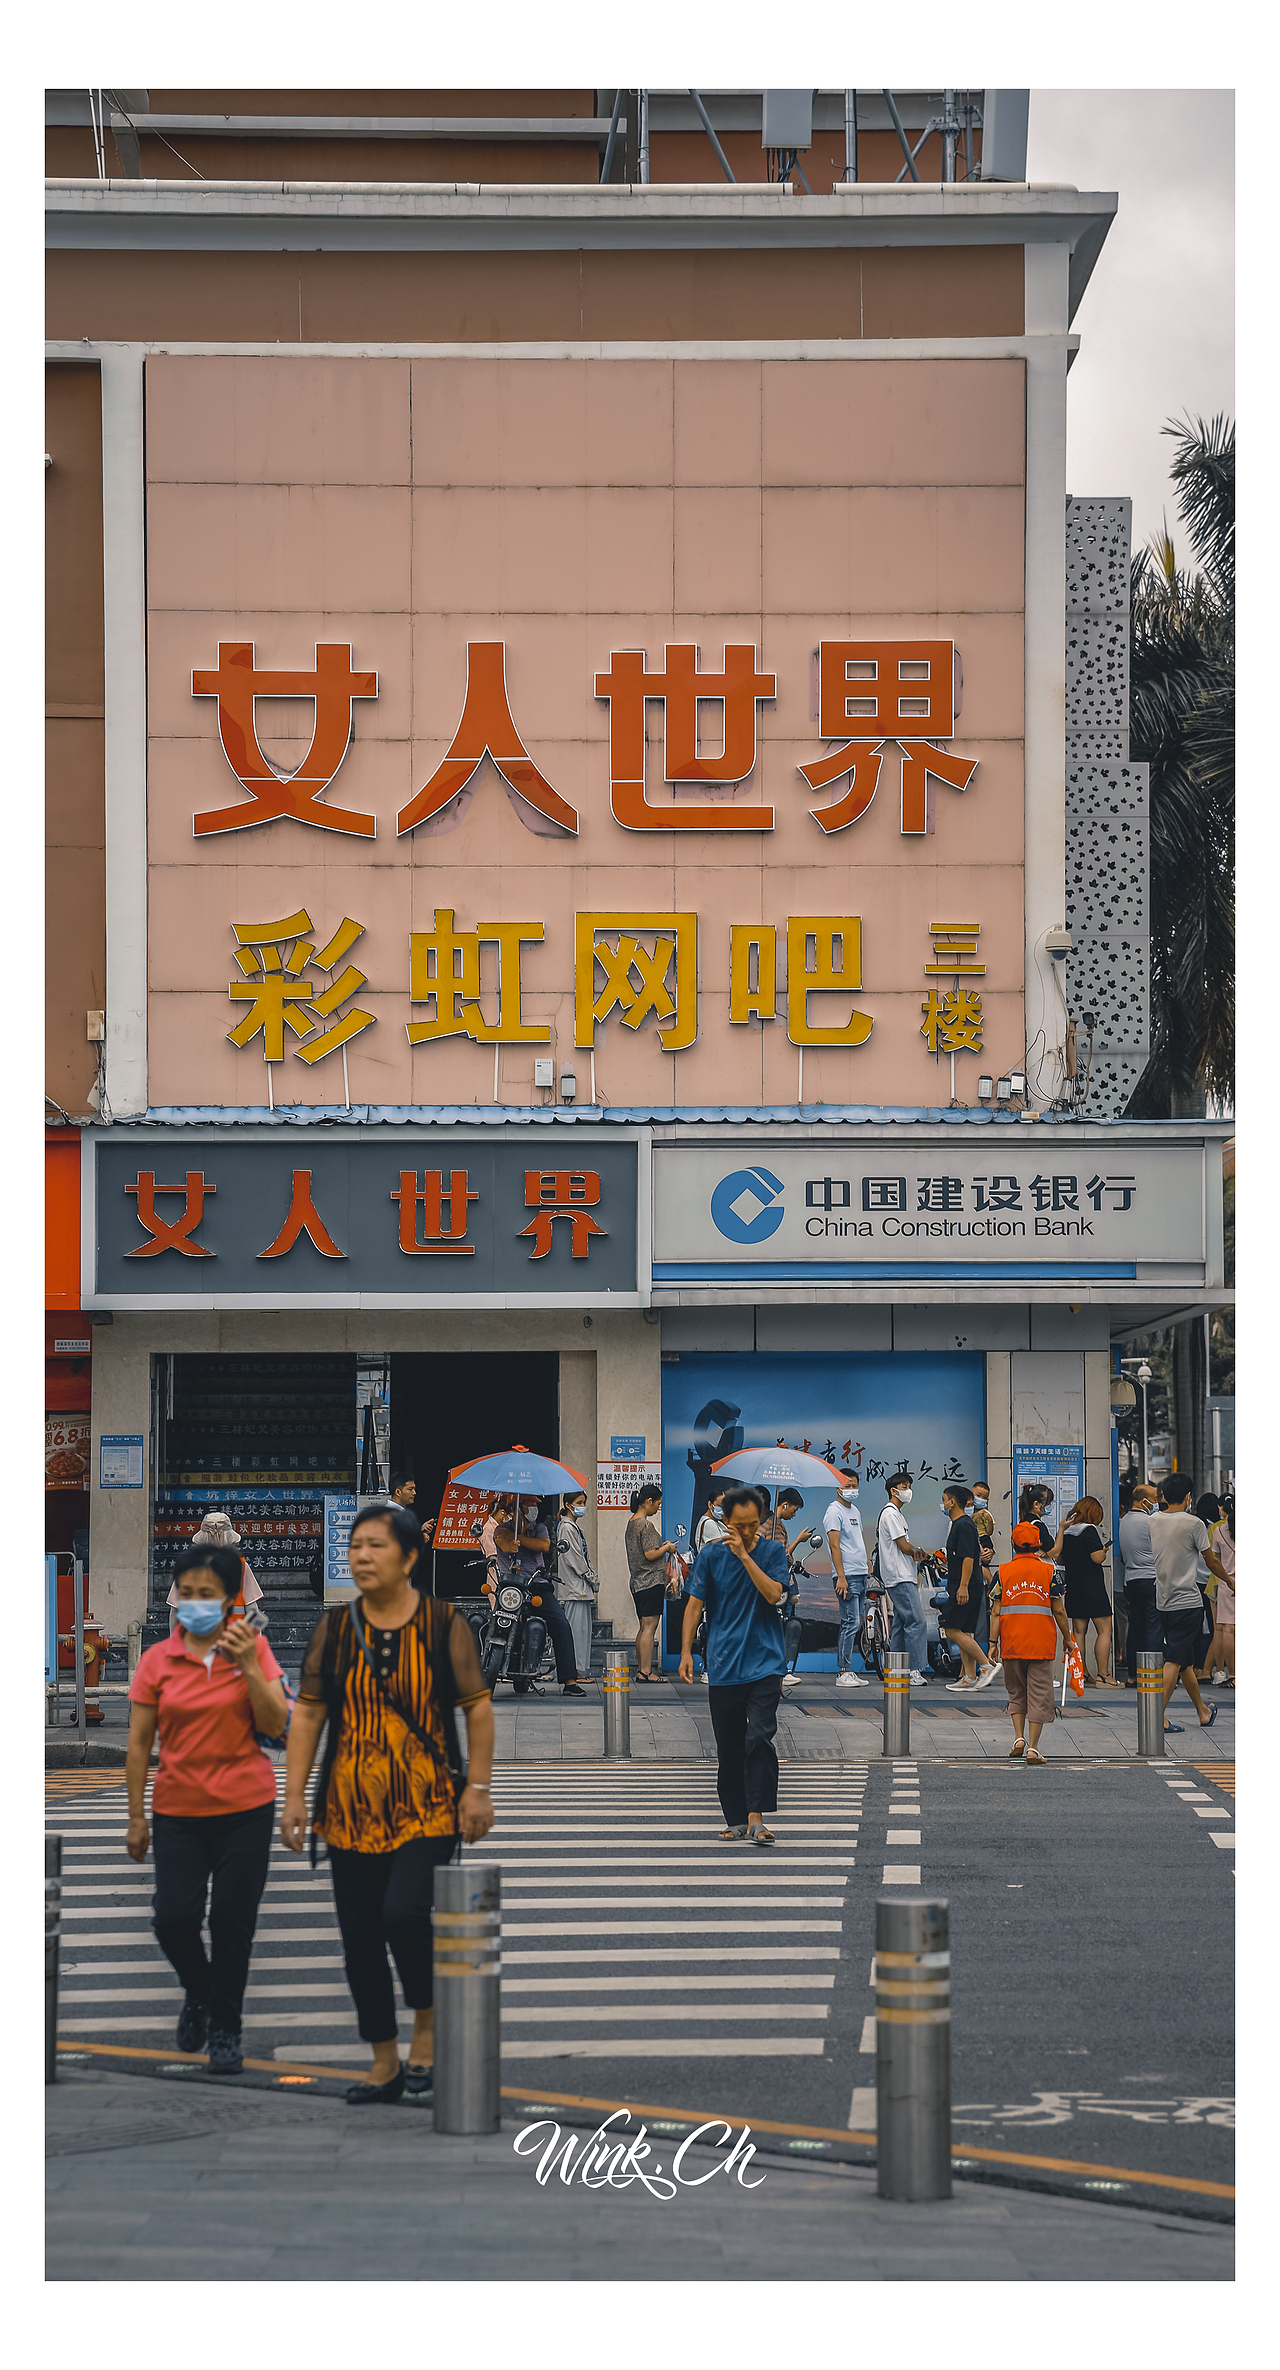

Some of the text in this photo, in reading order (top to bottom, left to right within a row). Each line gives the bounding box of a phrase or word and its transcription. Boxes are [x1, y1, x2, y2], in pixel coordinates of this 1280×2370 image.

[191, 639, 980, 838] 女人世界
[225, 907, 874, 1065] 彩虹网吧
[920, 921, 987, 1054] 三楼
[804, 1173, 1137, 1212] 中国建设银行
[124, 1168, 609, 1260] 女人世界
[805, 1216, 1095, 1238] China Construction Bank
[54, 1428, 79, 1446] 6.8
[777, 1437, 864, 1468] 建者行
[598, 1481, 661, 1490] 保管好你的个
[233, 1523, 321, 1534] 欢迎您中央空调
